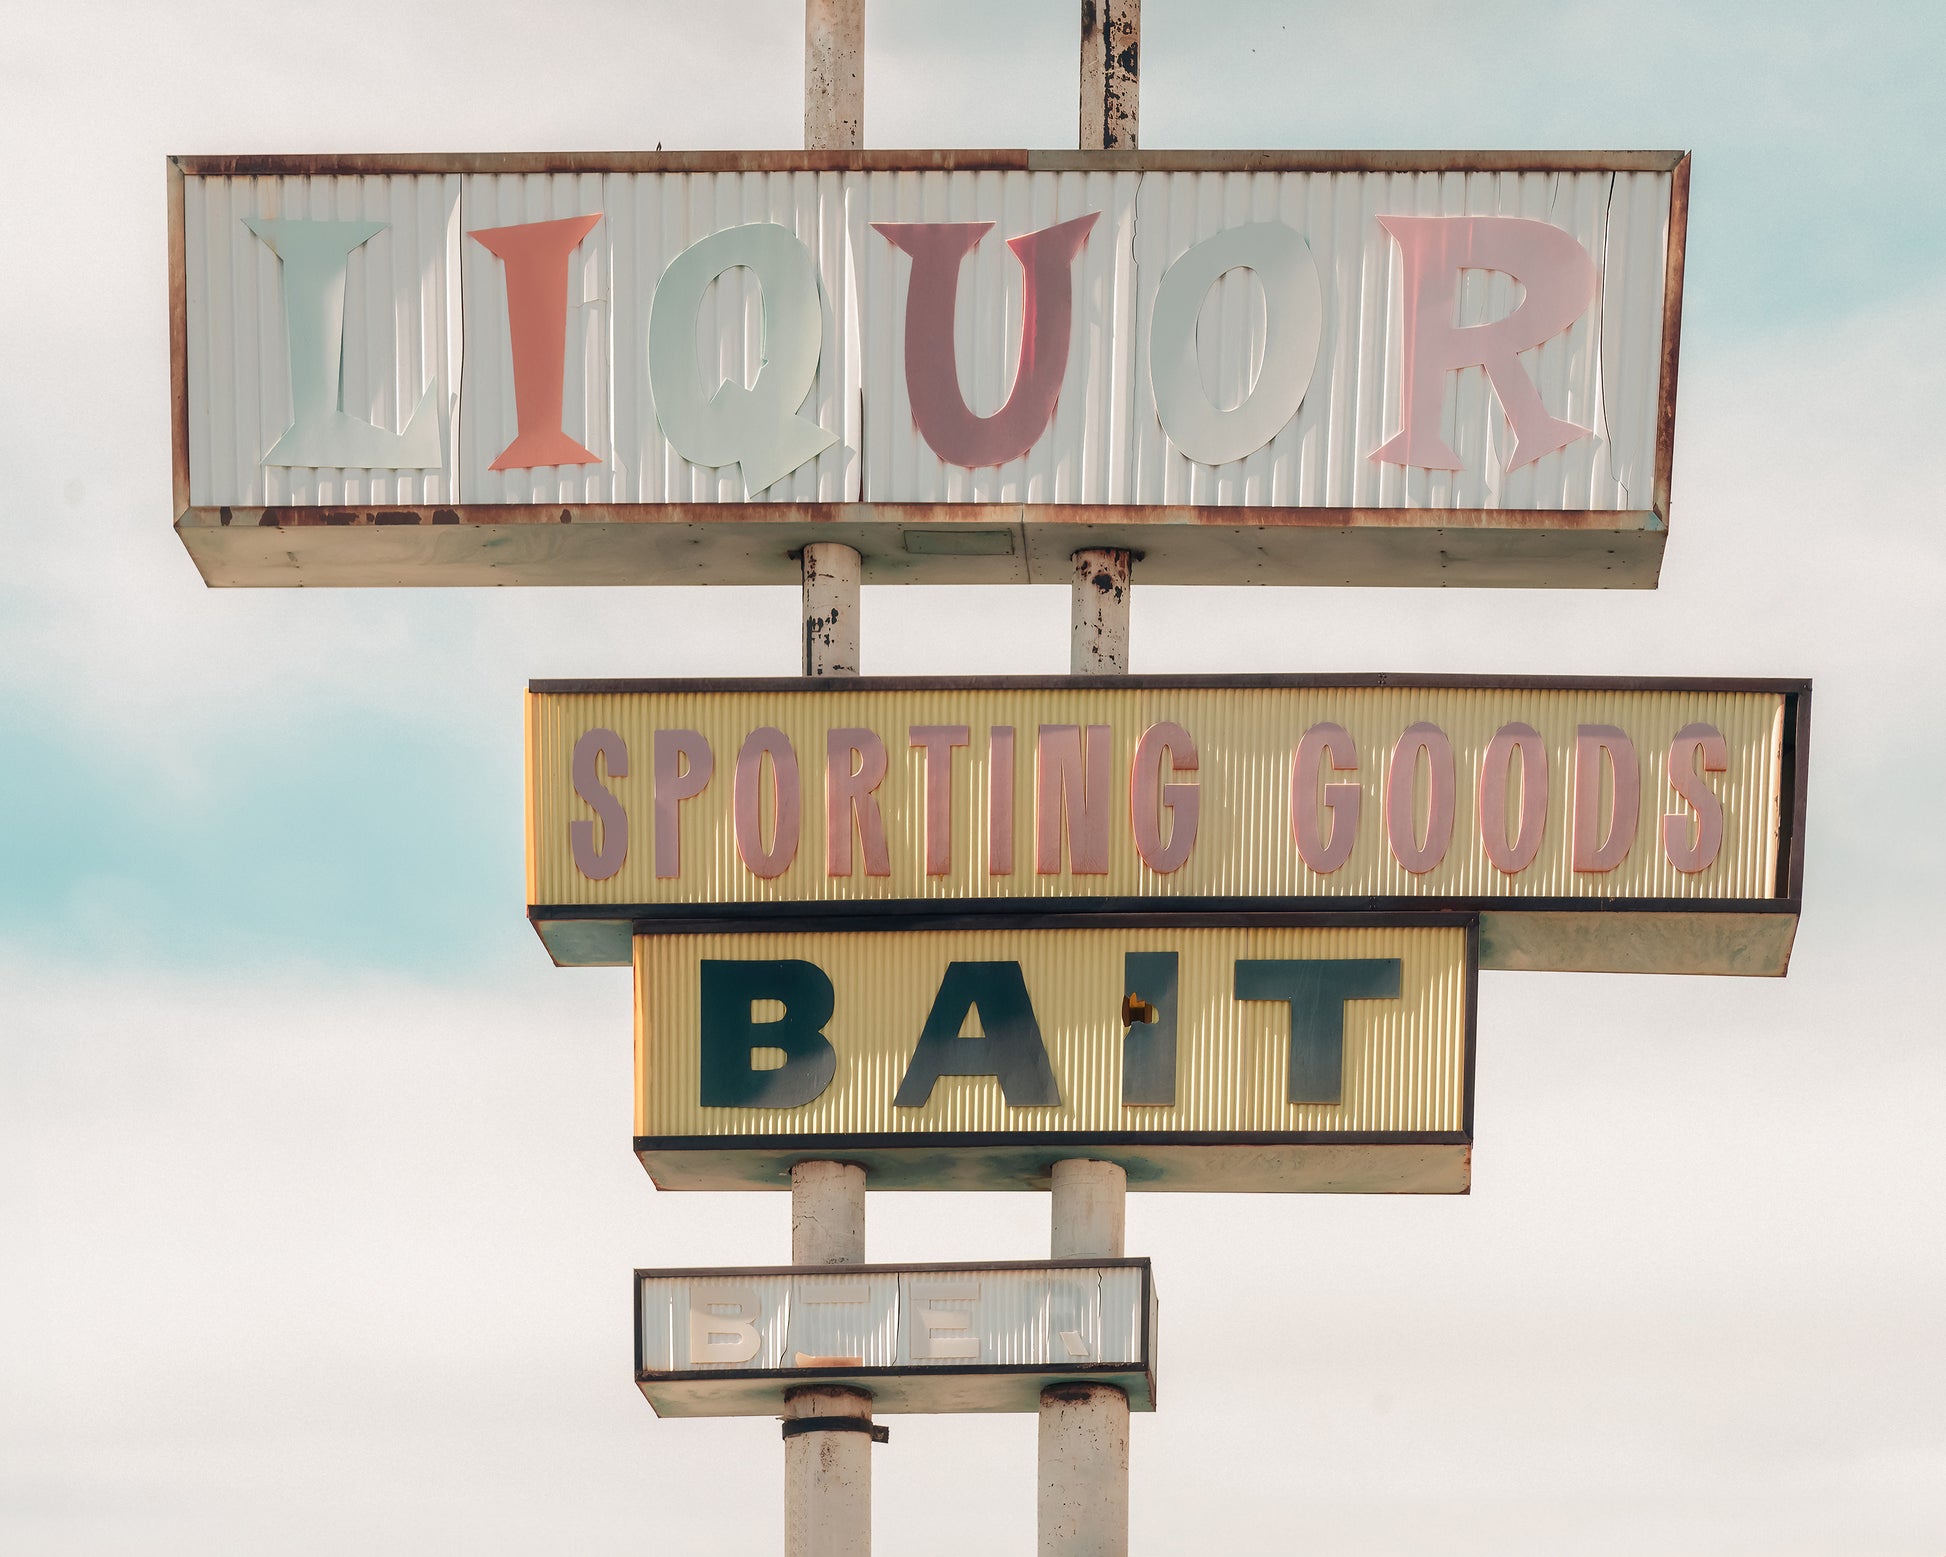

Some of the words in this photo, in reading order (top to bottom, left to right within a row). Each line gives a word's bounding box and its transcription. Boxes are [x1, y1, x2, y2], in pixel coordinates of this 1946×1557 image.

[241, 210, 1598, 498] LIQUOR
[570, 721, 1201, 881] SPORTING
[1291, 721, 1728, 874] GOODS
[700, 951, 1402, 1107] BAIT
[689, 1279, 1091, 1367] BE
